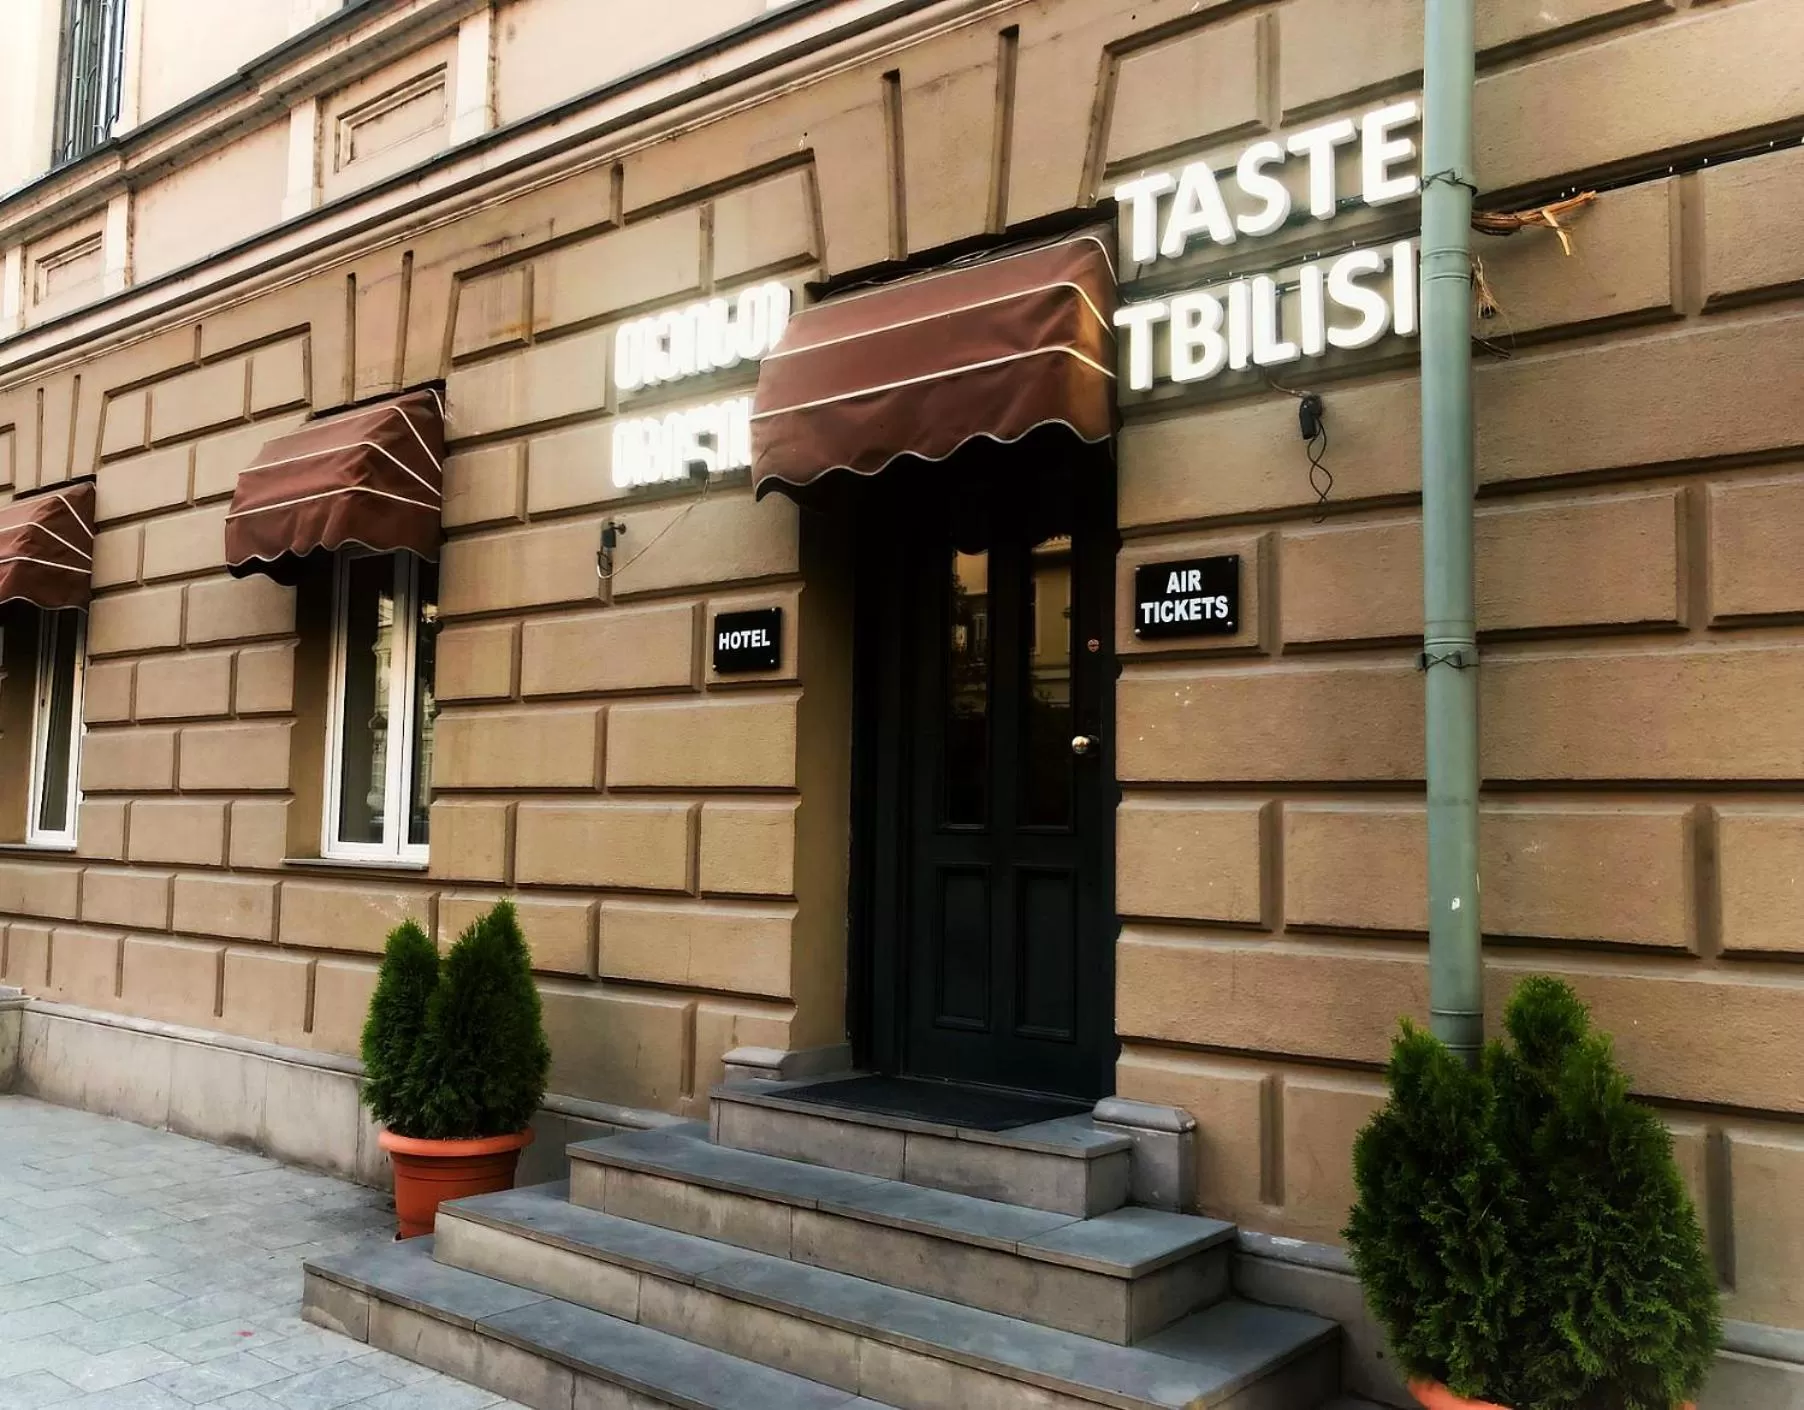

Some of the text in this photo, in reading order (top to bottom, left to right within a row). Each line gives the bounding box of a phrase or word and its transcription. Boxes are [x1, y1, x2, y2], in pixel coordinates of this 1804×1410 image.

[1114, 101, 1421, 264] TASTE
[1113, 241, 1419, 392] TBILISI
[1166, 569, 1202, 594] AIR
[1140, 595, 1229, 624] TICKETS
[718, 628, 771, 650] HOTEL
